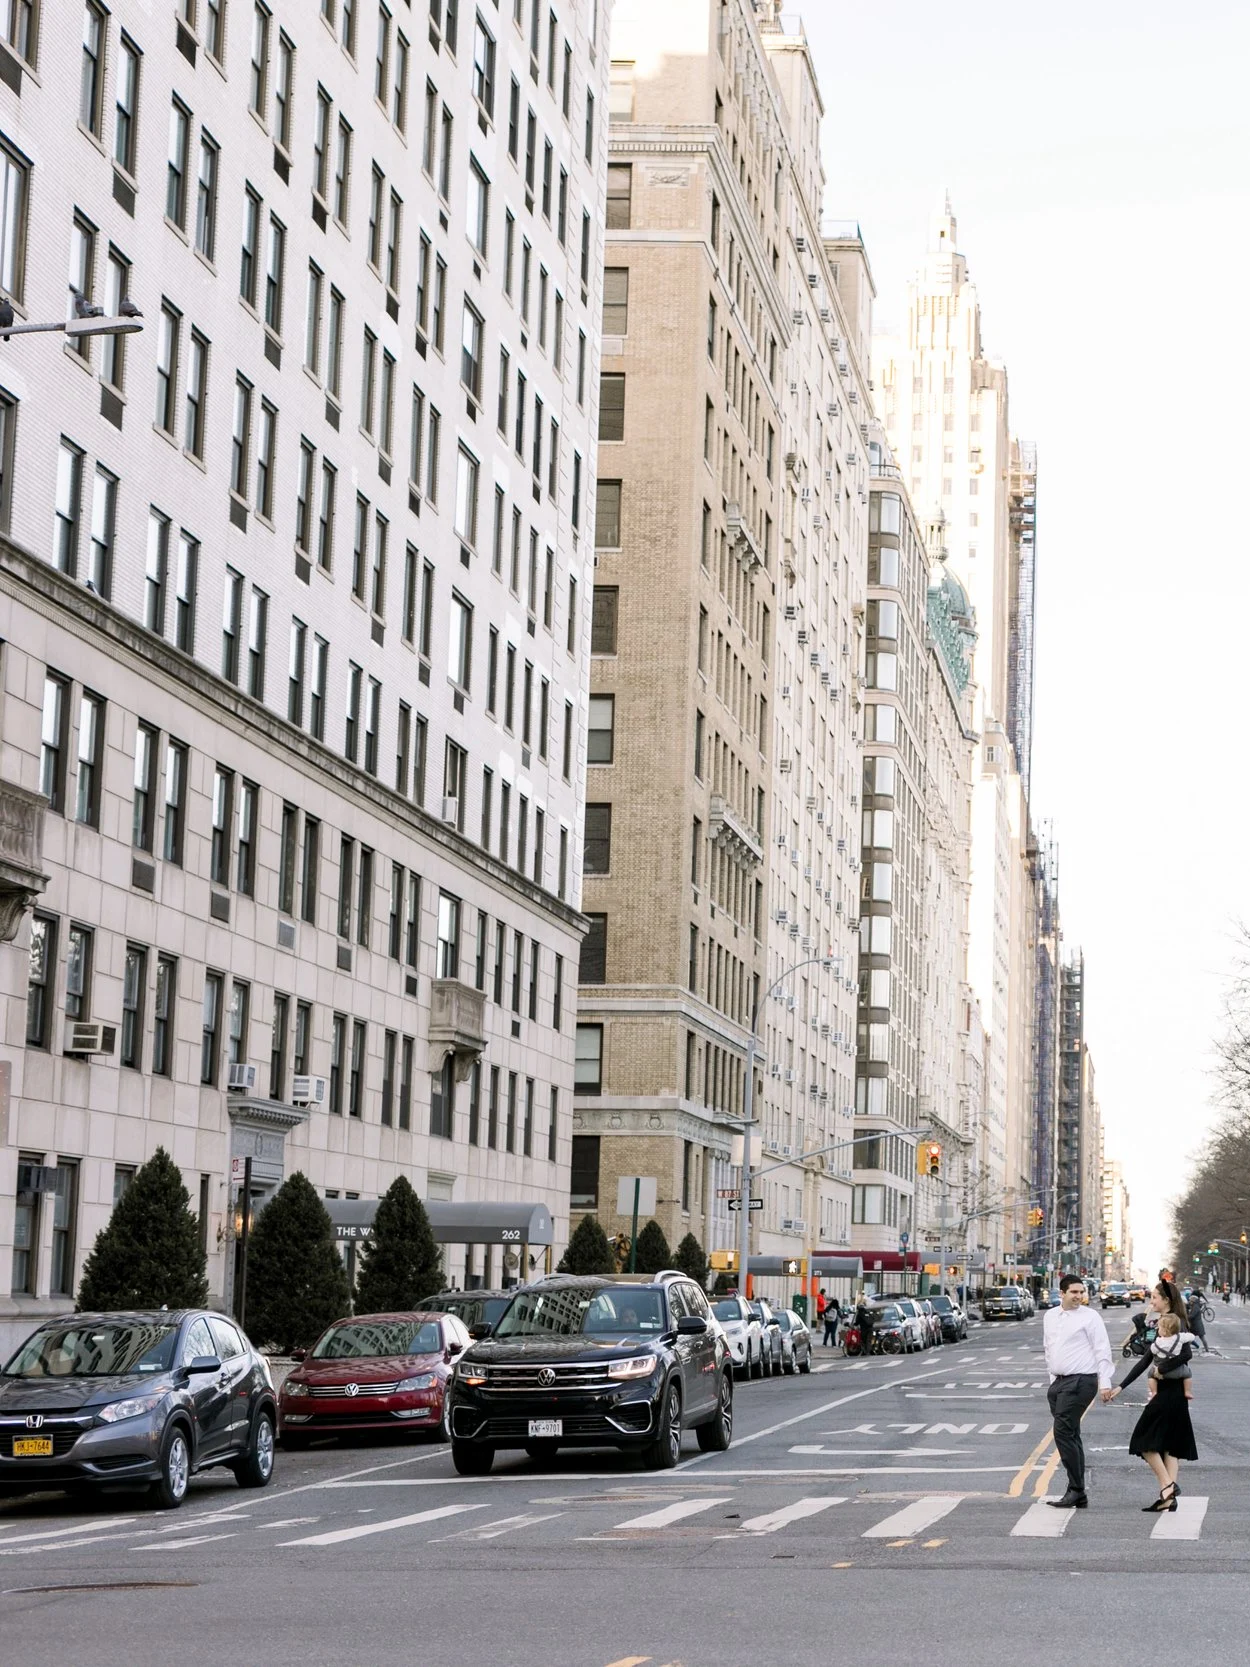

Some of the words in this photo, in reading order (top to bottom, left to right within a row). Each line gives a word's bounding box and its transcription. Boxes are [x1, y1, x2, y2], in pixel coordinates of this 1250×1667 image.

[336, 1226, 357, 1237] THE
[501, 1230, 521, 1240] 262
[818, 1422, 1030, 1435] ONLY
